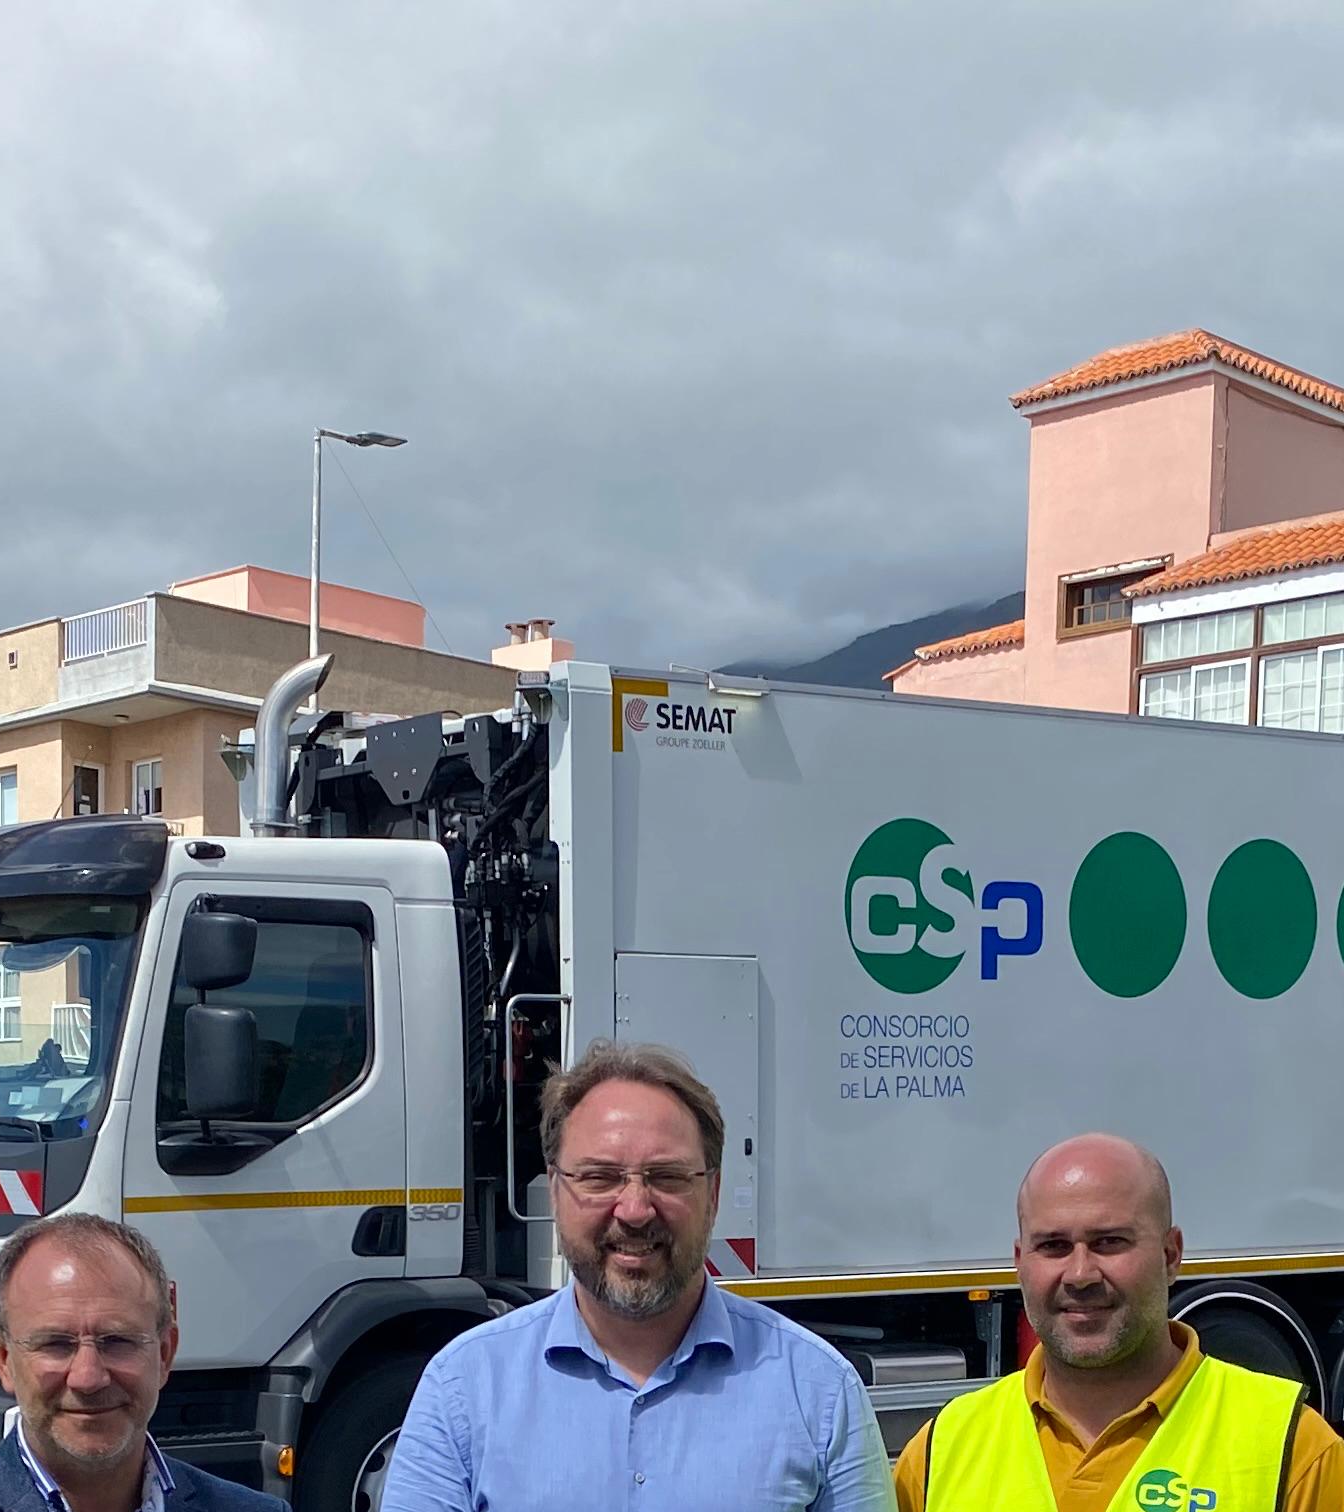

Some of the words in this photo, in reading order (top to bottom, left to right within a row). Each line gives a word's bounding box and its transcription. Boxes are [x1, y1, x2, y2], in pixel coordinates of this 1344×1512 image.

[656, 702, 736, 734] SEMAT
[656, 736, 690, 749] GROUPE
[692, 738, 727, 752] ZOELLER
[840, 1014, 970, 1038] CONSORCIO
[840, 1052, 860, 1069] DE
[863, 1045, 974, 1068] SERVICIOS
[840, 1082, 860, 1099] DE
[864, 1075, 890, 1098] LA
[896, 1075, 966, 1098] PALMA
[409, 1204, 461, 1221] 350
